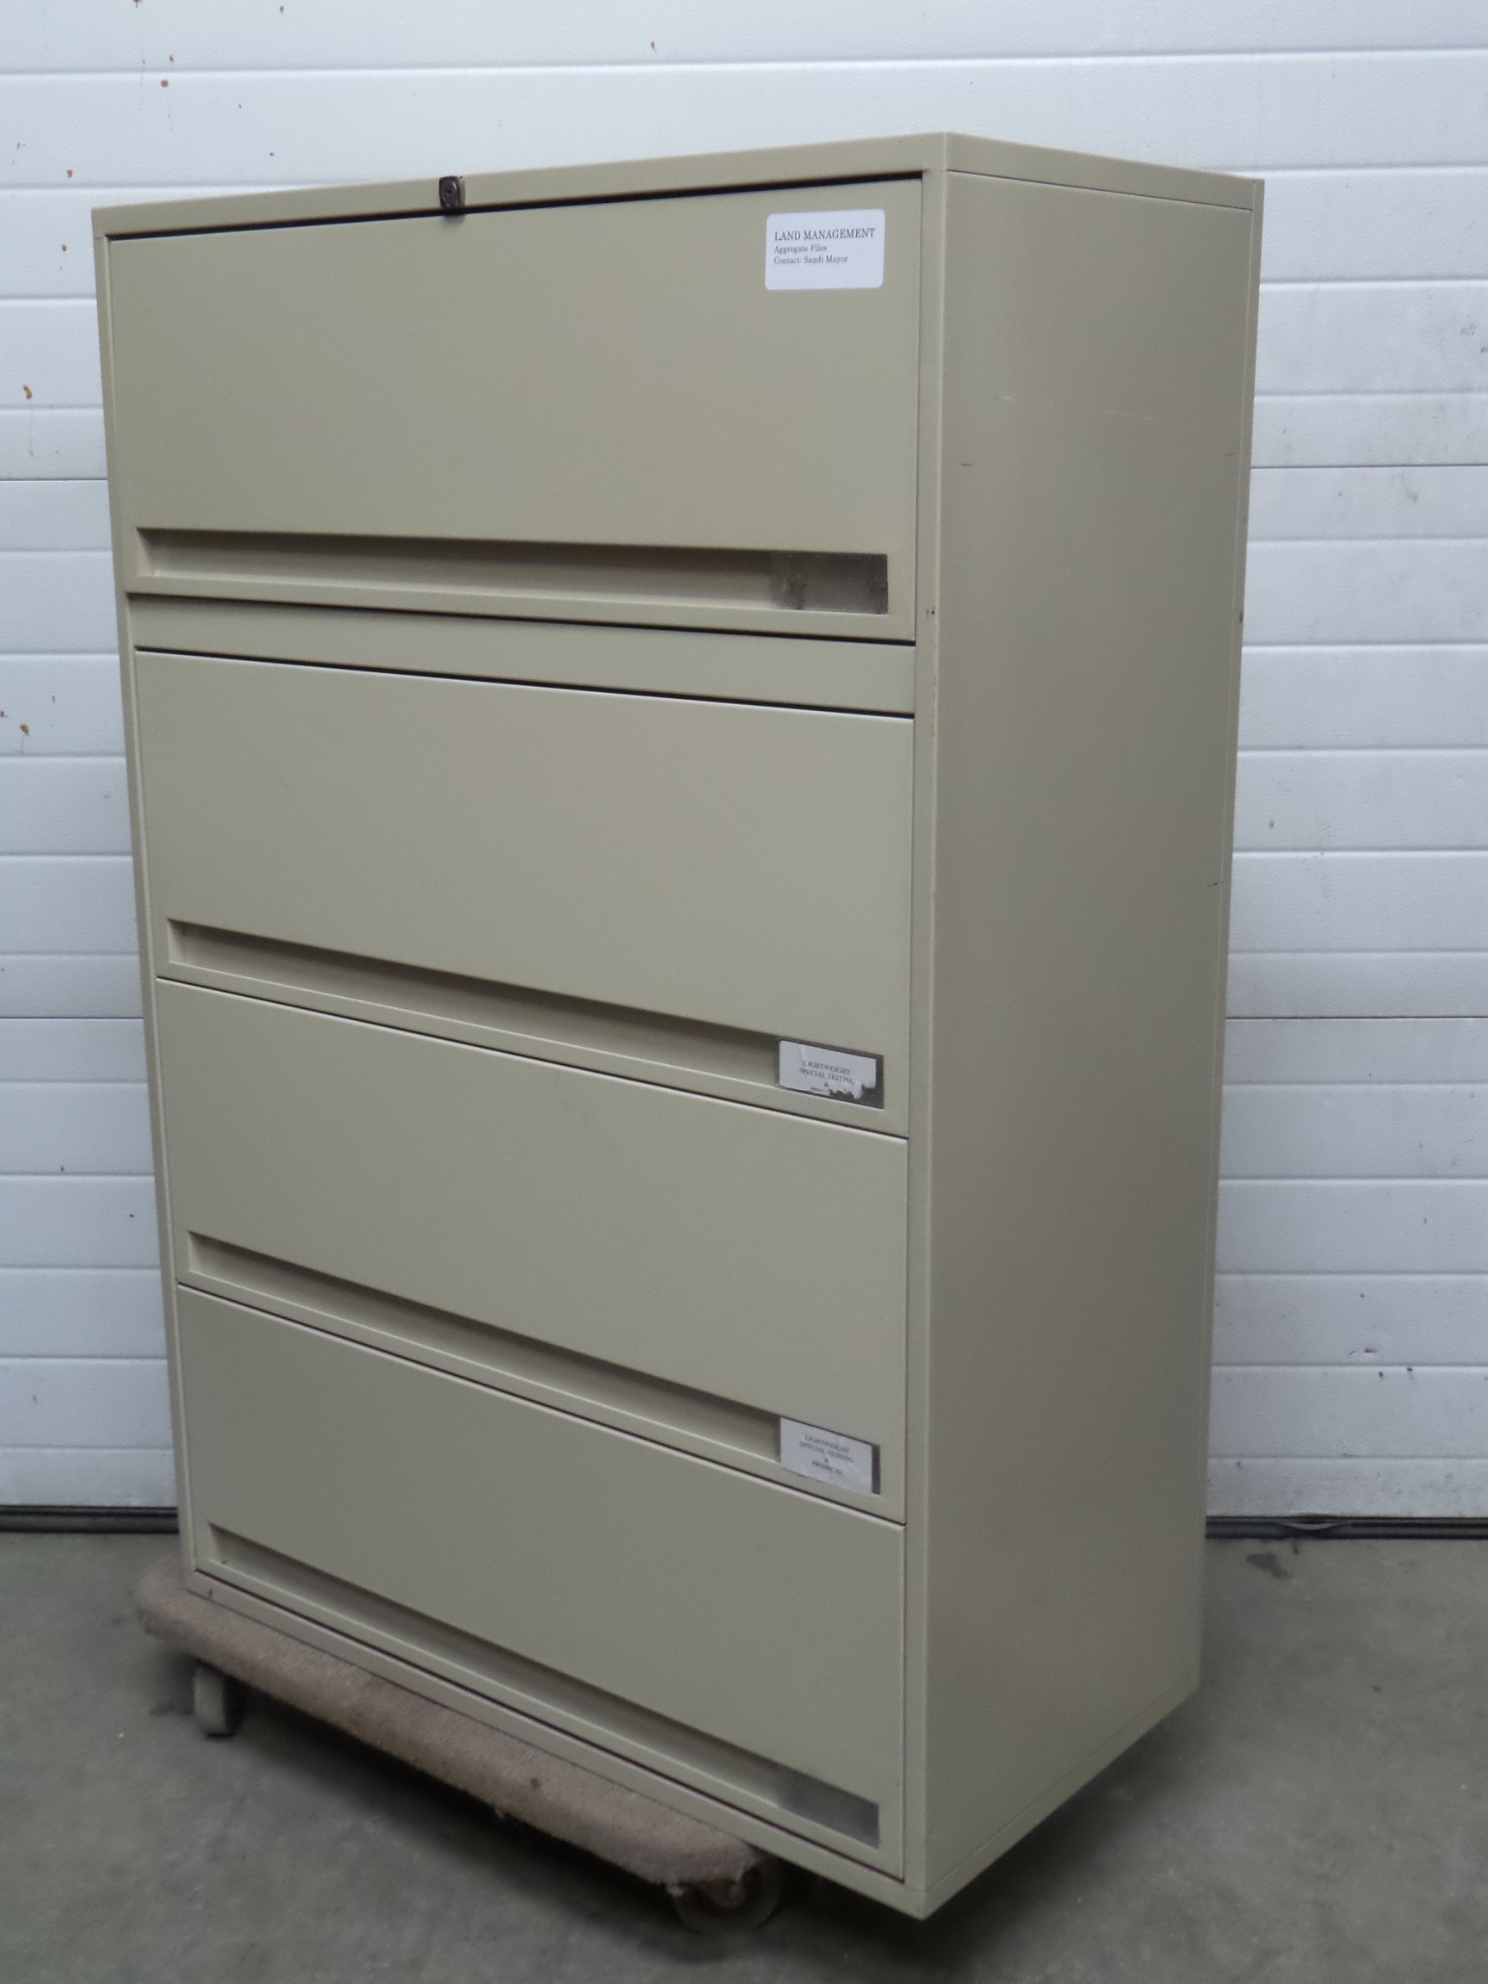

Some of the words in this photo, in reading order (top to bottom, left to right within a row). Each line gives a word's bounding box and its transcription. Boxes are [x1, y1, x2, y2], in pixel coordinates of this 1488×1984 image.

[774, 230, 801, 241] LAND
[803, 228, 876, 240] MANAGEMENT
[774, 245, 809, 254] Aggregate
[810, 243, 828, 252] Files
[803, 255, 824, 264] Sandi
[825, 255, 848, 265] Mayor
